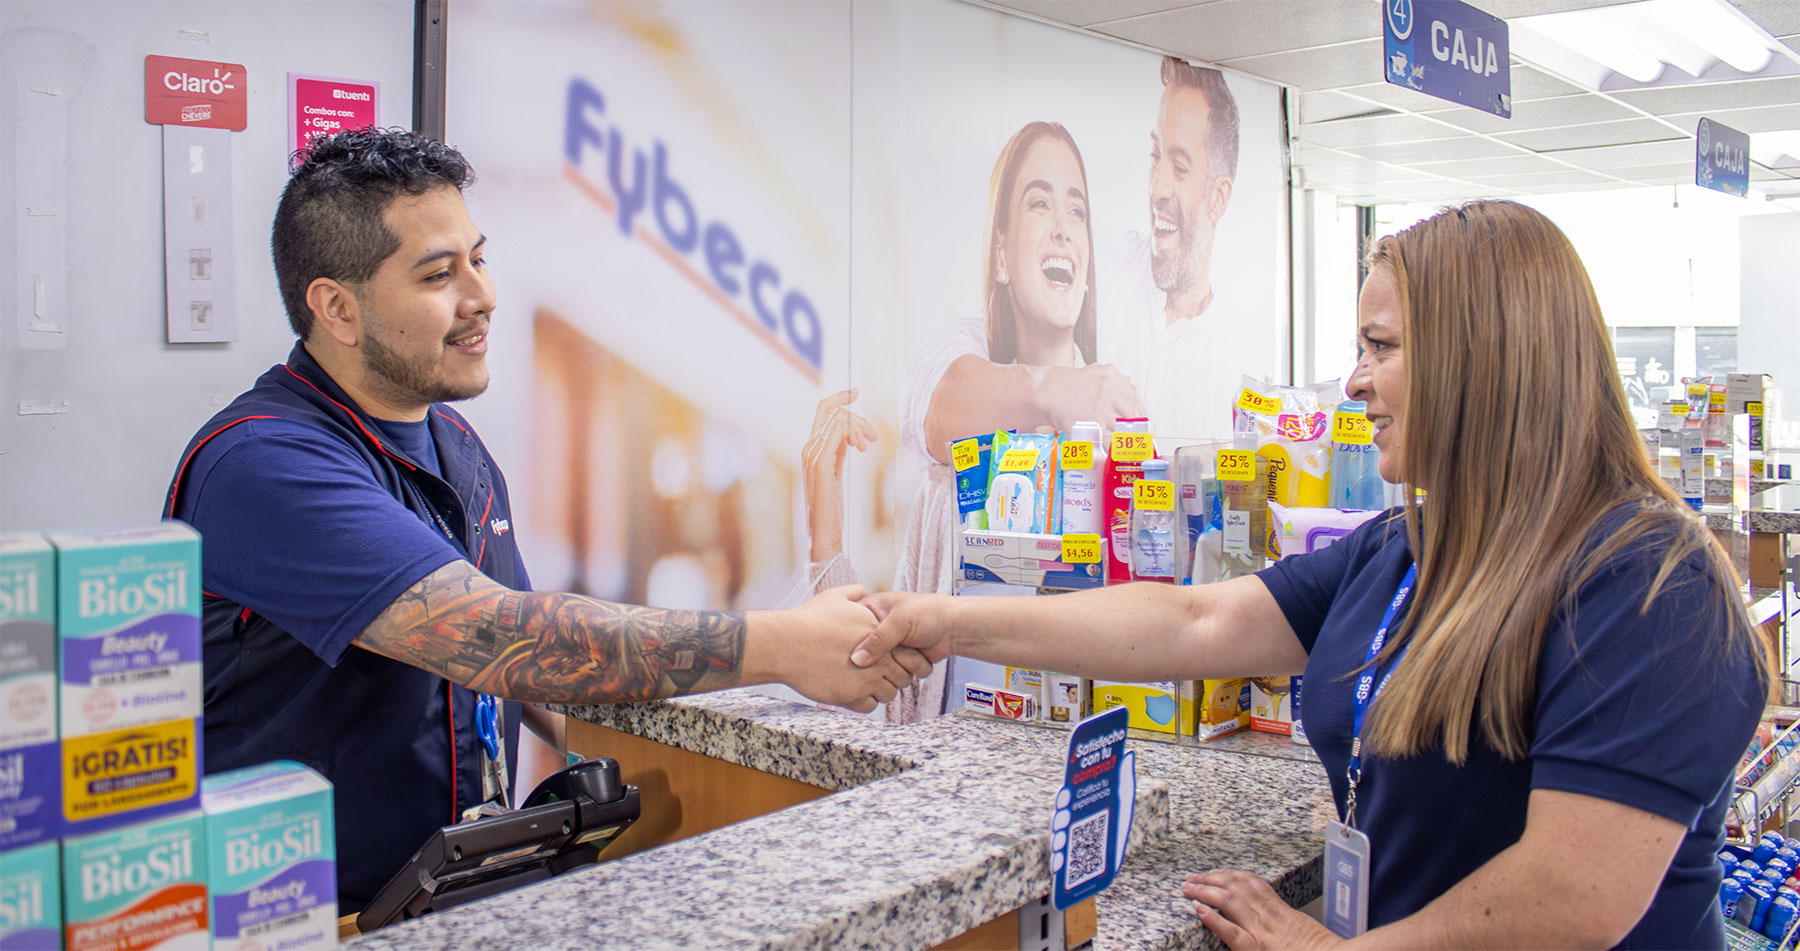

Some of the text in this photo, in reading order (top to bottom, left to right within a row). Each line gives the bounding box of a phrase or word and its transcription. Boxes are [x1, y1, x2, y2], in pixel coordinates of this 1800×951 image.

[1393, 0, 1406, 25] 4
[1431, 19, 1499, 78] CAJA
[164, 71, 224, 95] Claro
[342, 90, 370, 102] tuenti
[304, 106, 355, 117] Combos con:
[313, 117, 341, 130] Gigas
[1715, 141, 1745, 176] CAJA
[564, 76, 824, 371] Fybeca
[1243, 391, 1275, 408] 30%
[1285, 415, 1302, 441] 120
[1338, 416, 1367, 432] 15%
[1063, 445, 1088, 458] 20%
[1116, 436, 1147, 449] 30%
[1338, 443, 1375, 454] Dove
[1220, 454, 1250, 468] 25%
[1139, 485, 1168, 499] 15%
[964, 536, 1005, 546] SCANMED
[1066, 548, 1093, 559] $4,56
[79, 569, 188, 618] BioSil
[1392, 586, 1409, 610] GBS
[101, 630, 168, 656] Beauty
[1372, 628, 1386, 653] GBS
[1357, 676, 1372, 701] GBS
[1070, 728, 1125, 764] ¿Satisfecho
[1080, 746, 1112, 769] con tu
[72, 737, 188, 780] ¡GRATIS!
[1072, 755, 1117, 785] compra?
[1071, 788, 1111, 812] experiencia
[1076, 779, 1110, 800] Califica tu
[225, 819, 322, 877] BioSil
[81, 837, 194, 903] BioSil
[248, 879, 307, 909] Beauty
[72, 895, 206, 949] PERFORMANCE
